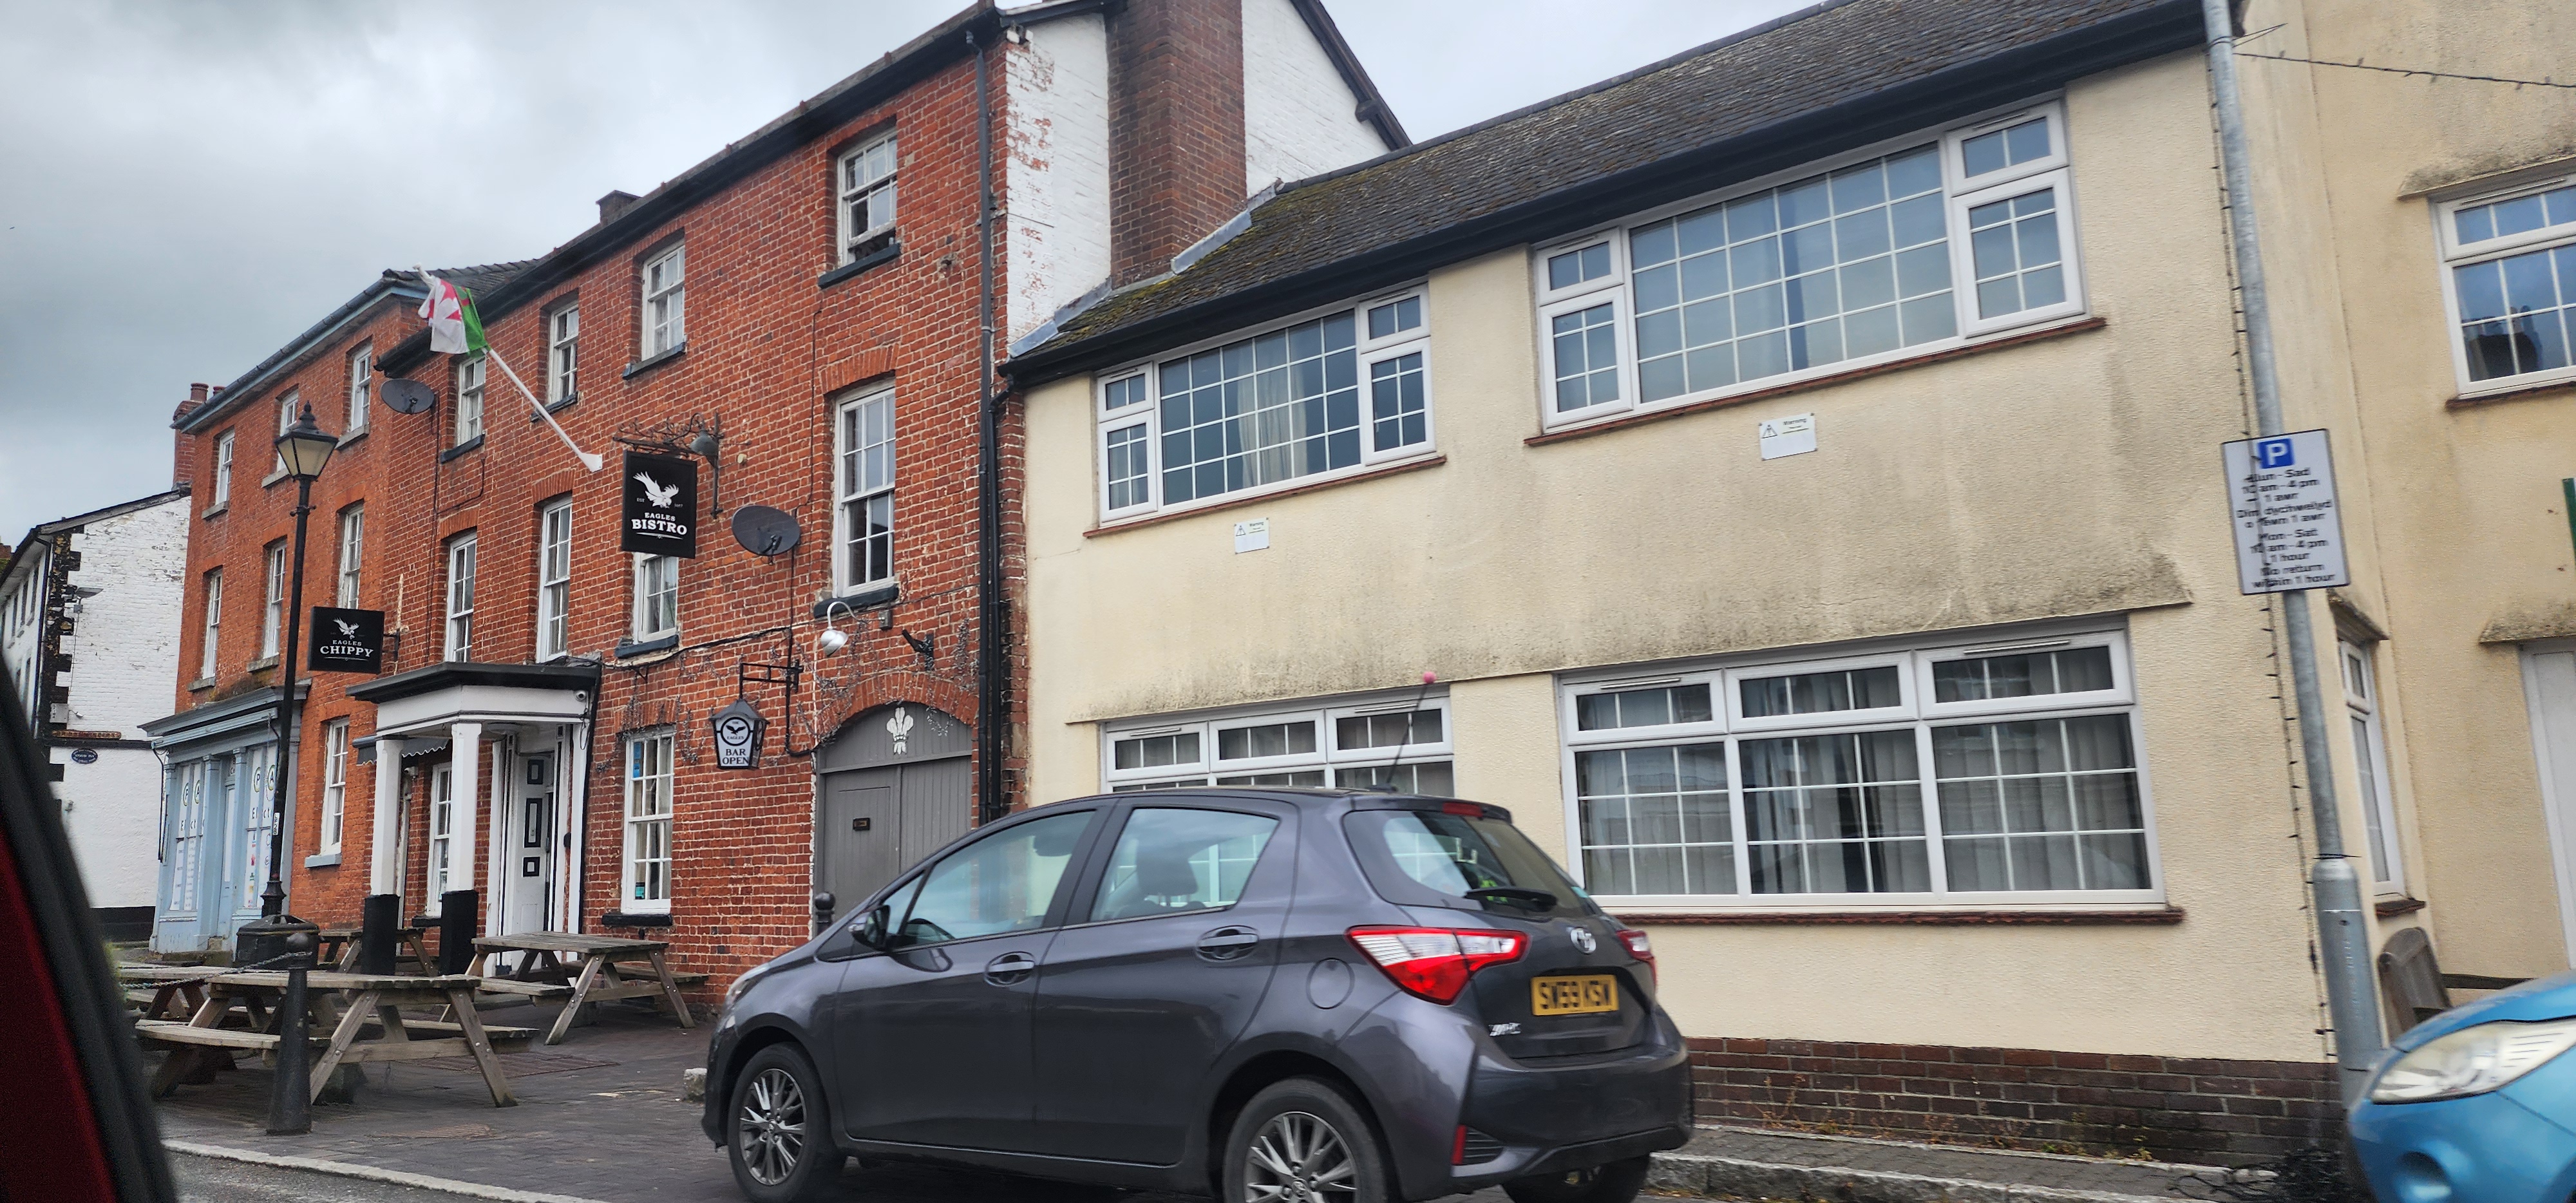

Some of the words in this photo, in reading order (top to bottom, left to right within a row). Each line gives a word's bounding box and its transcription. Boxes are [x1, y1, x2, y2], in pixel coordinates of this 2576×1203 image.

[2266, 443, 2287, 466] P
[2284, 468, 2311, 478] Sad
[2298, 479, 2320, 489] pm
[2273, 493, 2298, 502] awr
[2236, 509, 2260, 518] Dim
[2264, 499, 2333, 515] dychwelyd
[644, 512, 676, 522] EAGLES
[2300, 513, 2326, 522] awr
[631, 519, 687, 535] BISTRO
[2295, 528, 2318, 538] Sat
[2307, 540, 2329, 549] pm
[2280, 553, 2310, 562] hour
[2282, 564, 2325, 574] return
[2251, 576, 2292, 587] within
[2304, 573, 2336, 583] hour
[320, 645, 374, 657] CHIPPY
